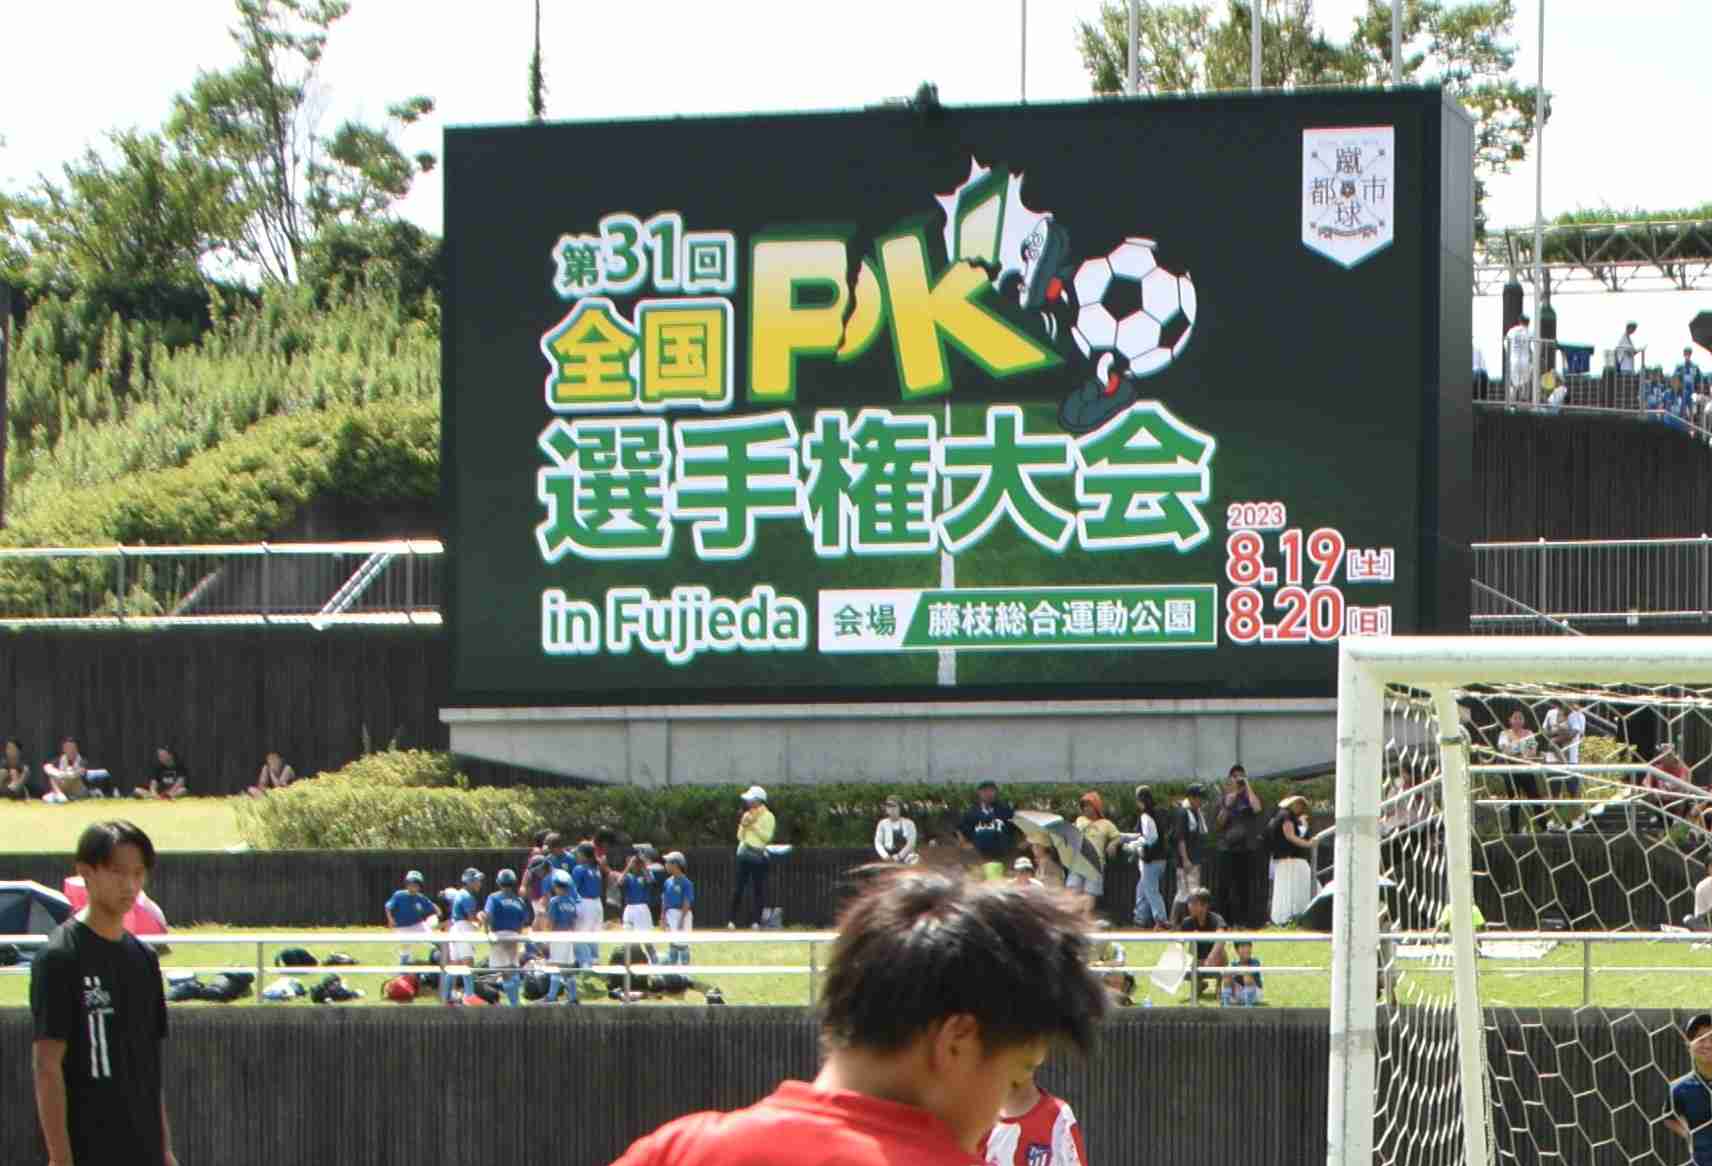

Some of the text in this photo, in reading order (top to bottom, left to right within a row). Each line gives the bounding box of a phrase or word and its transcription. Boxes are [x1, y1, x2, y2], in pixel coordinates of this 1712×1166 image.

[557, 217, 732, 291] 第31回
[750, 190, 1056, 399] PK
[545, 300, 732, 408] 全国
[538, 403, 1212, 560] 選手権大会
[1228, 504, 1286, 529] 2023
[544, 586, 806, 662] in Fujieda
[832, 603, 897, 637] 会場
[927, 599, 1196, 636] 藤枝総合運動公園
